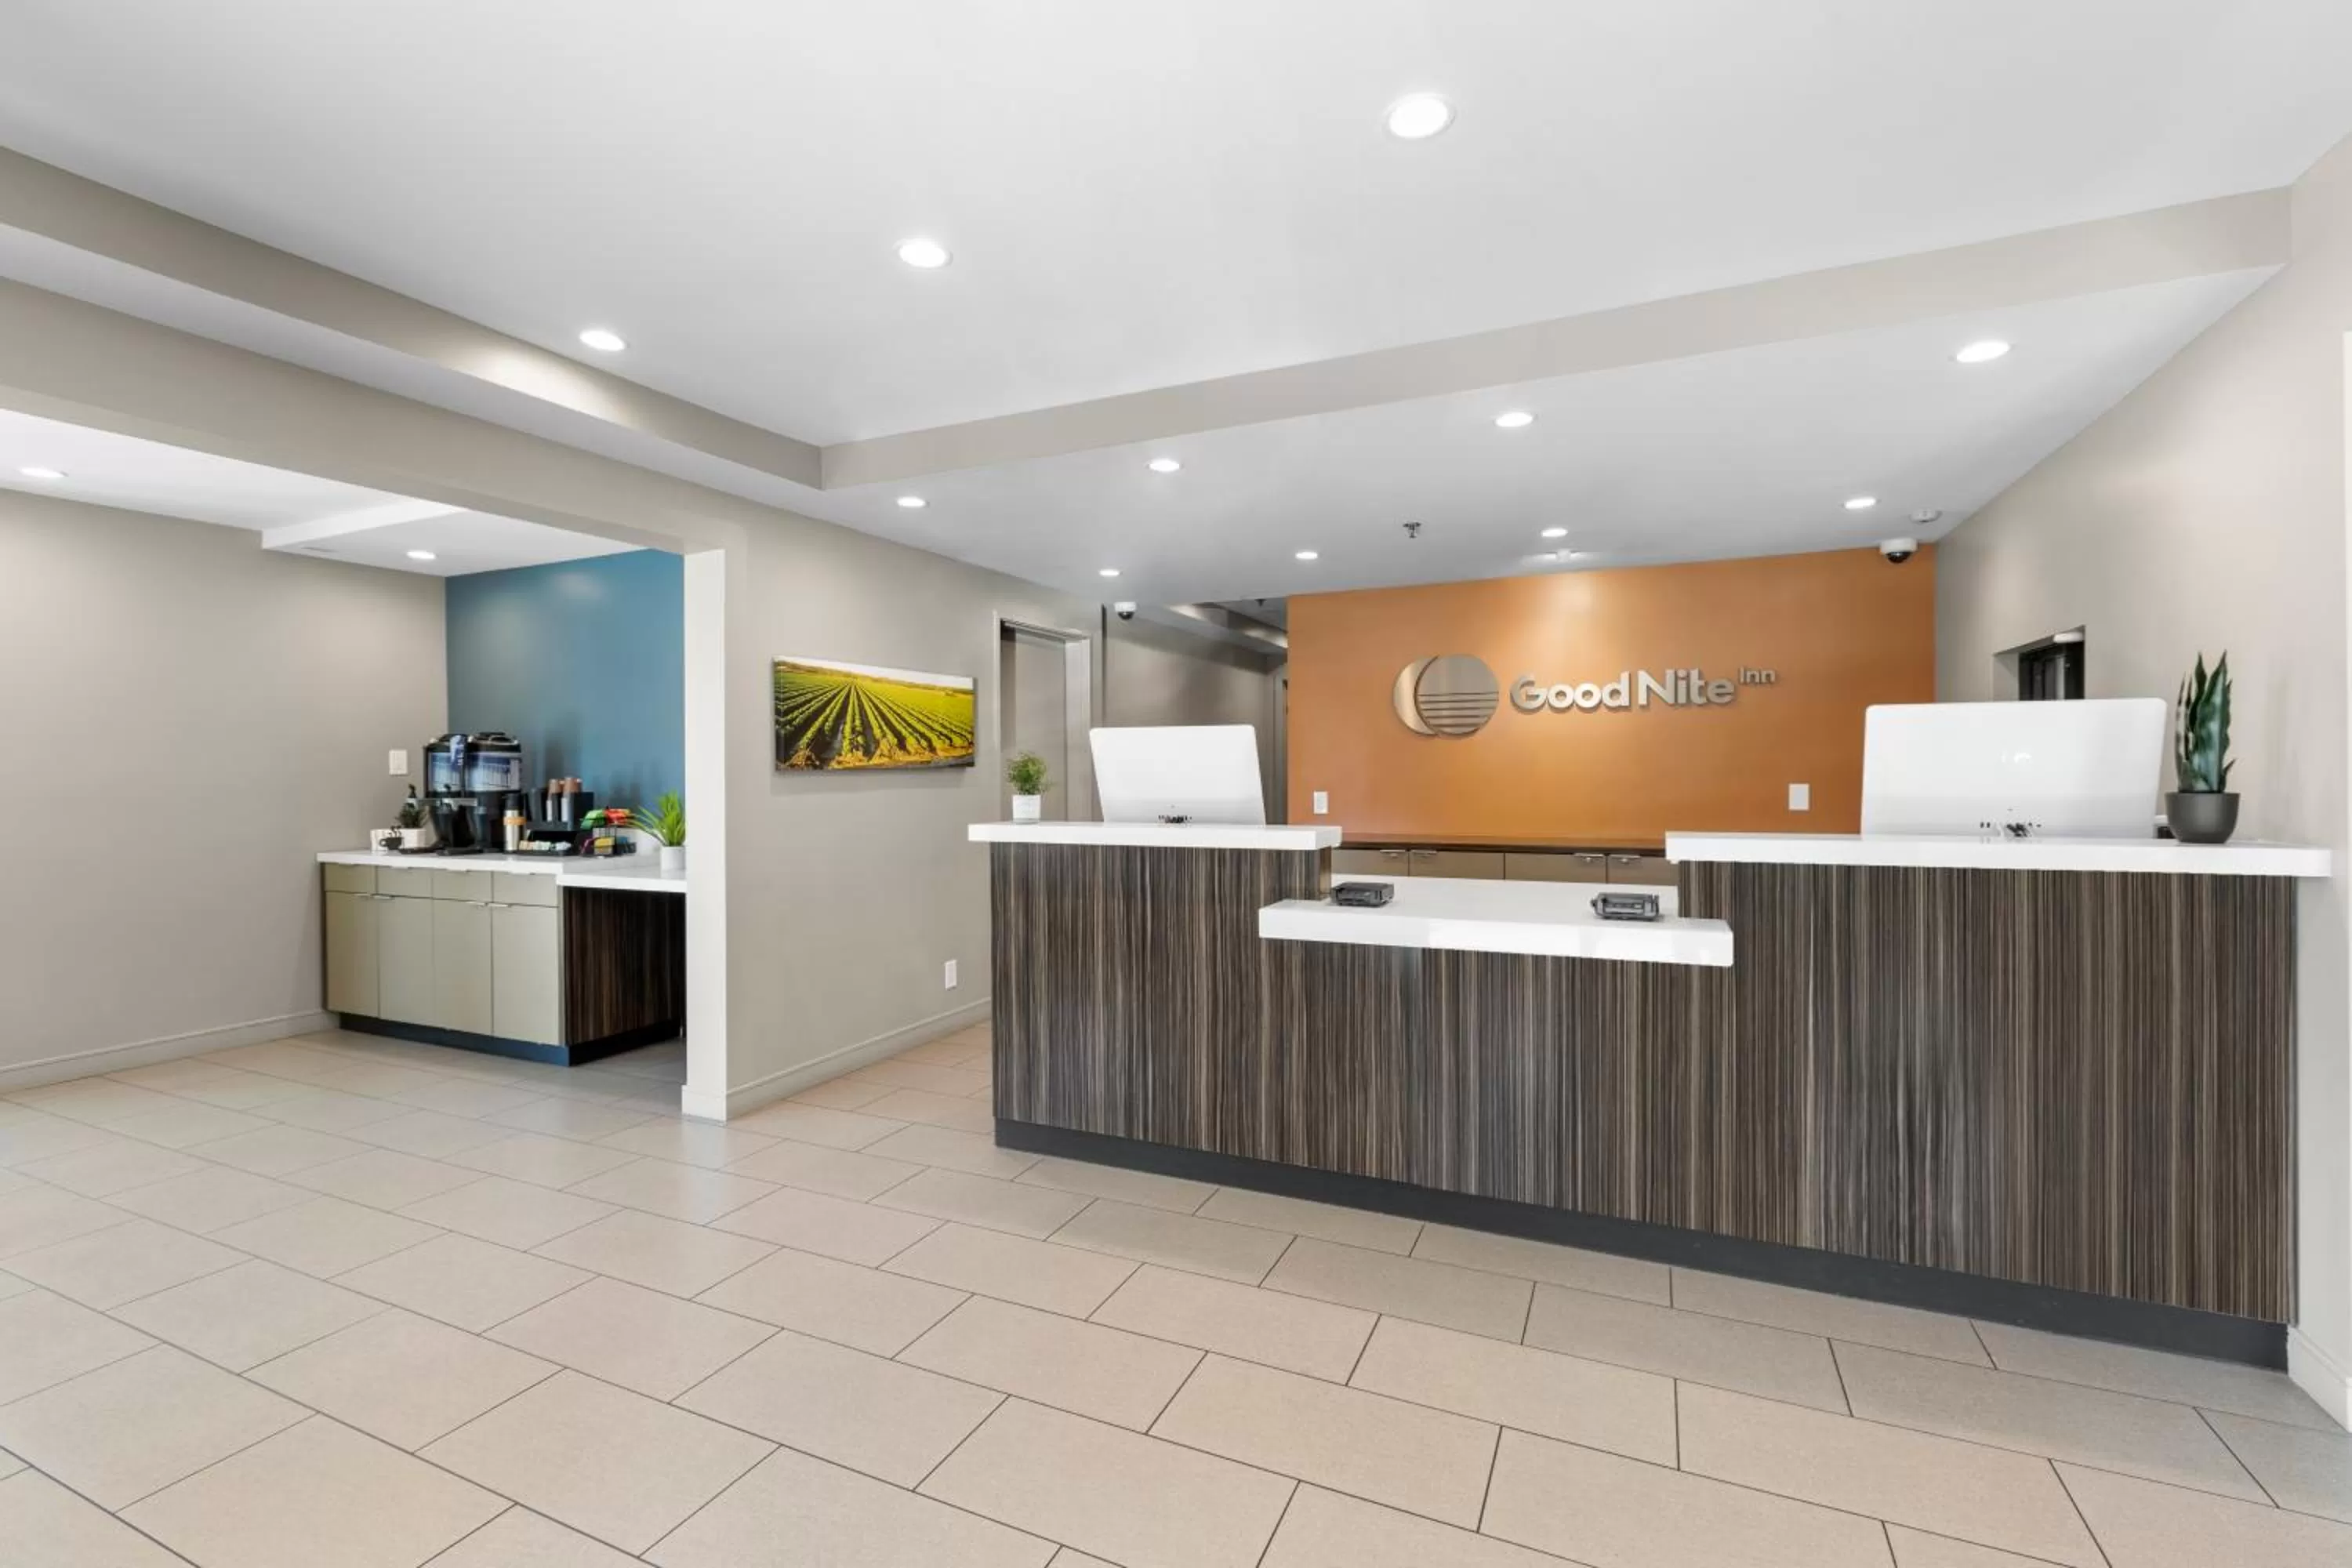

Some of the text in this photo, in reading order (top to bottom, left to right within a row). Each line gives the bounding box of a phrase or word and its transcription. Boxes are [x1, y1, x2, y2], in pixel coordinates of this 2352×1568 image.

[1510, 666, 1777, 710] Good Nite Inn
